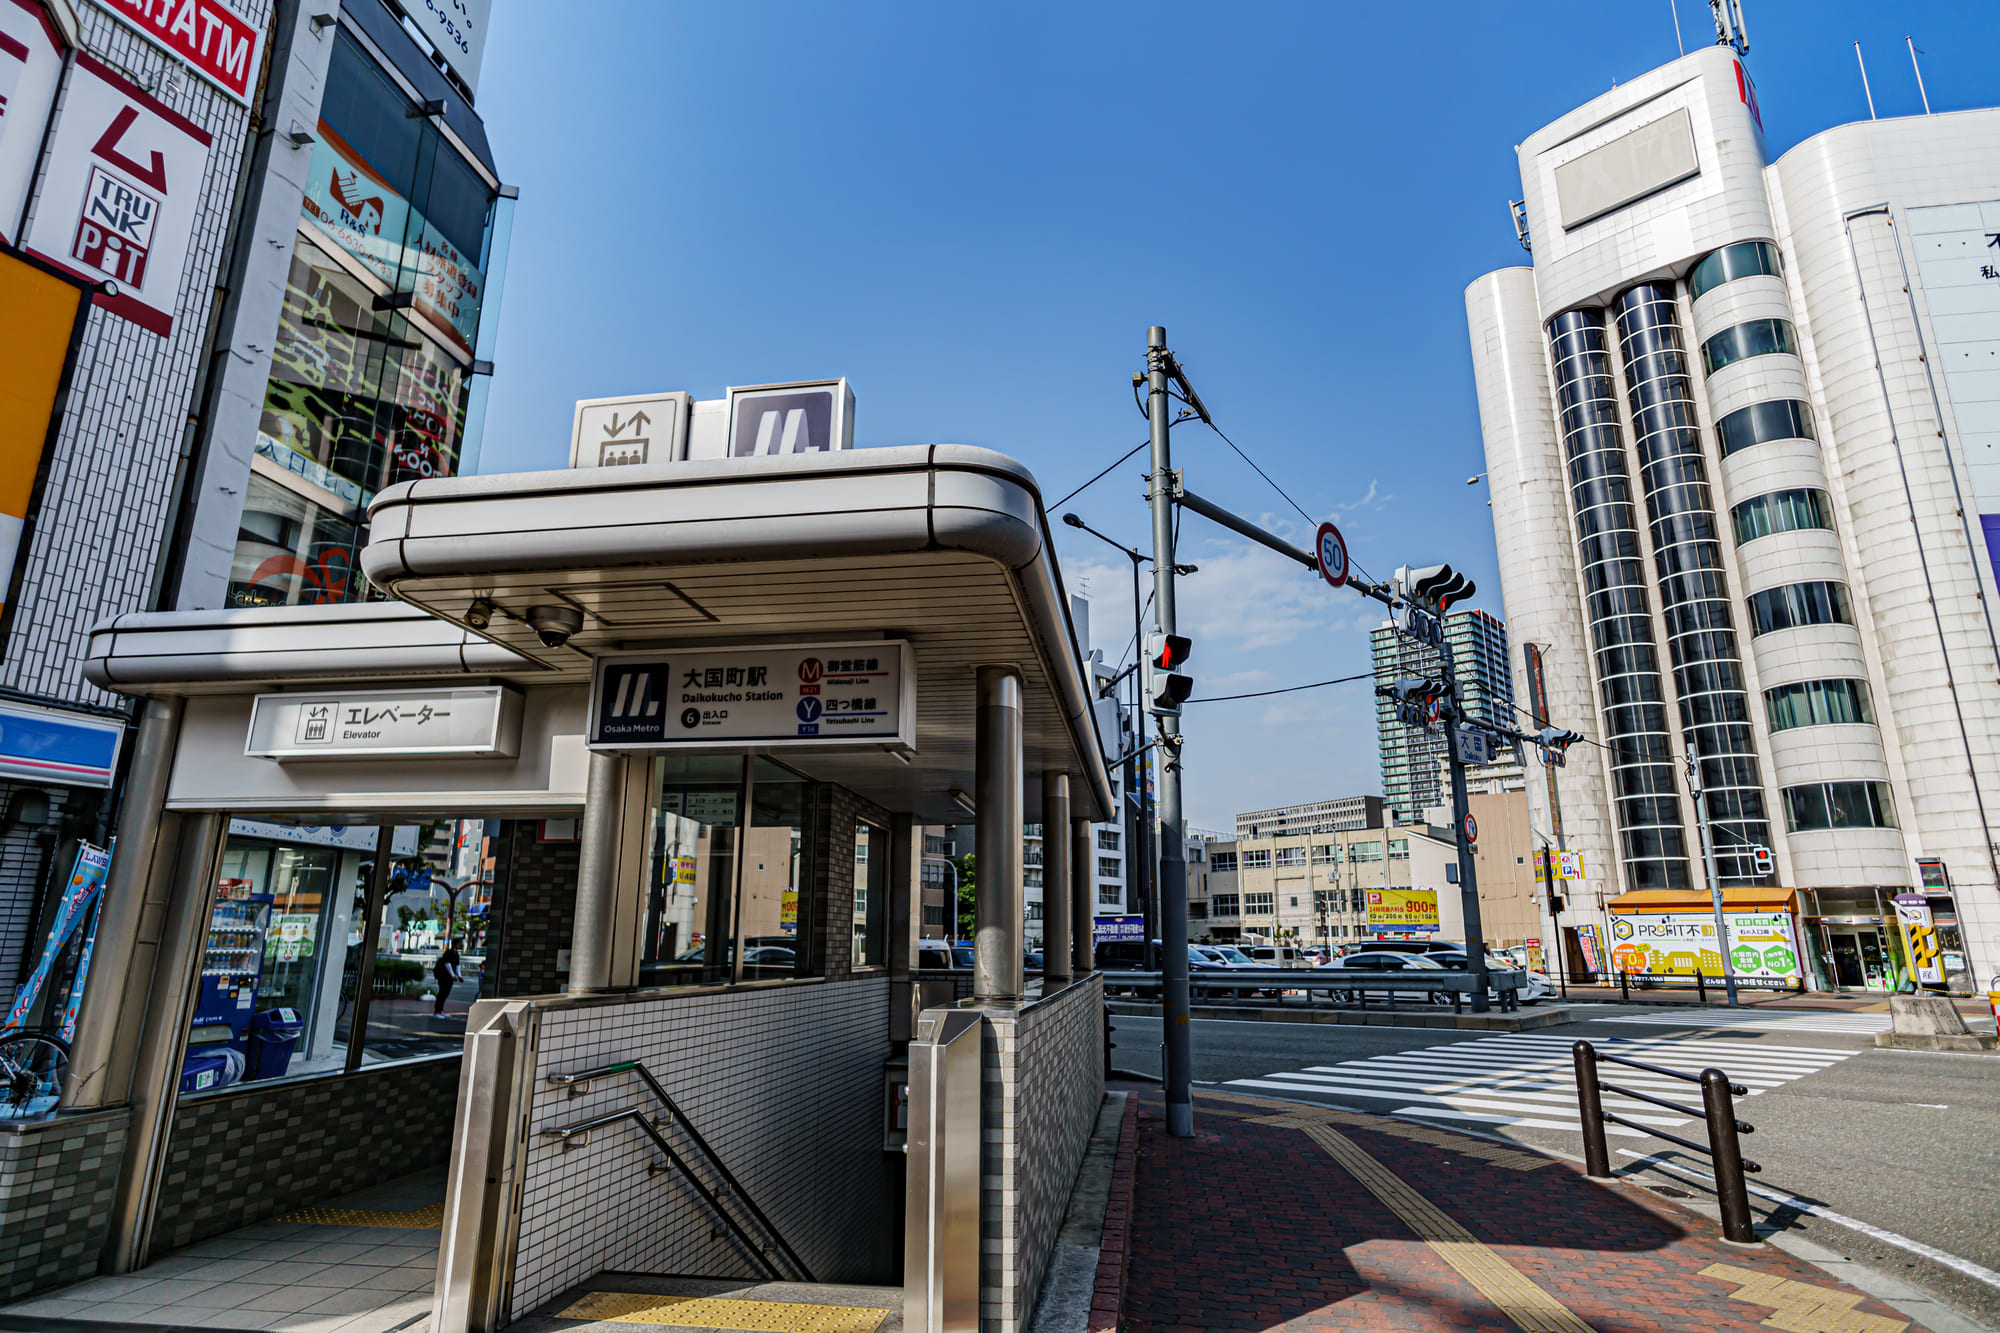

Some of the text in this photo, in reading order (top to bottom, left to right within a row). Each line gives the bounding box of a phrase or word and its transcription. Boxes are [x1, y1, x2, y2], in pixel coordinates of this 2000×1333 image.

[99, 175, 151, 222] TRU
[90, 195, 146, 243] NK
[340, 208, 366, 238] R&S
[1323, 537, 1342, 571] 50
[682, 666, 767, 689] 大国町駅
[801, 661, 819, 680] M
[856, 677, 869, 685] Line
[682, 689, 783, 704] Daikokucho Station
[826, 698, 877, 711] 四つ橋線
[344, 705, 451, 726] エレベーター
[702, 710, 728, 720] 出入口
[802, 700, 815, 719] Y
[686, 712, 695, 725] 6
[860, 716, 875, 724] Line
[342, 730, 381, 740] Elevator
[604, 723, 660, 734] Osaka Metro
[1460, 734, 1483, 752] 大国
[1406, 901, 1437, 913] 900円
